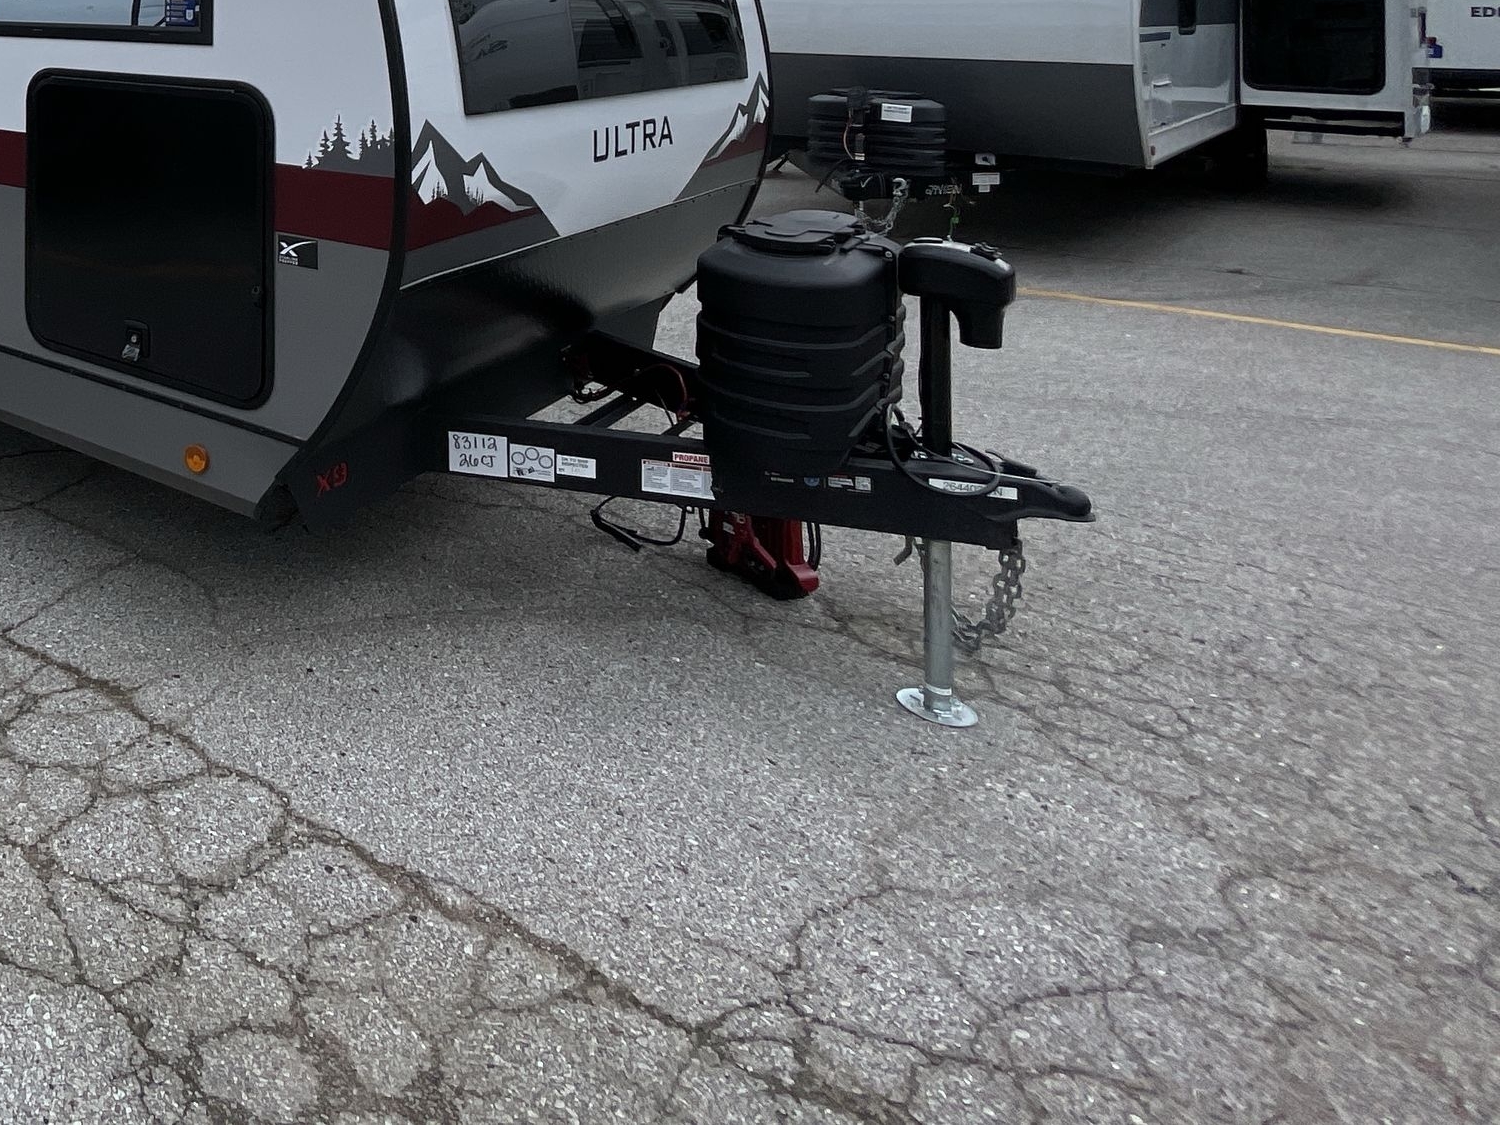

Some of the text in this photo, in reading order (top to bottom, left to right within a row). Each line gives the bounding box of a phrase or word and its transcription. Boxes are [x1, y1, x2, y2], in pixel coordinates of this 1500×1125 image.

[1470, 6, 1500, 18] ED
[593, 115, 673, 163] ULTRA
[452, 434, 498, 451] 83112
[674, 454, 708, 464] PROPANE
